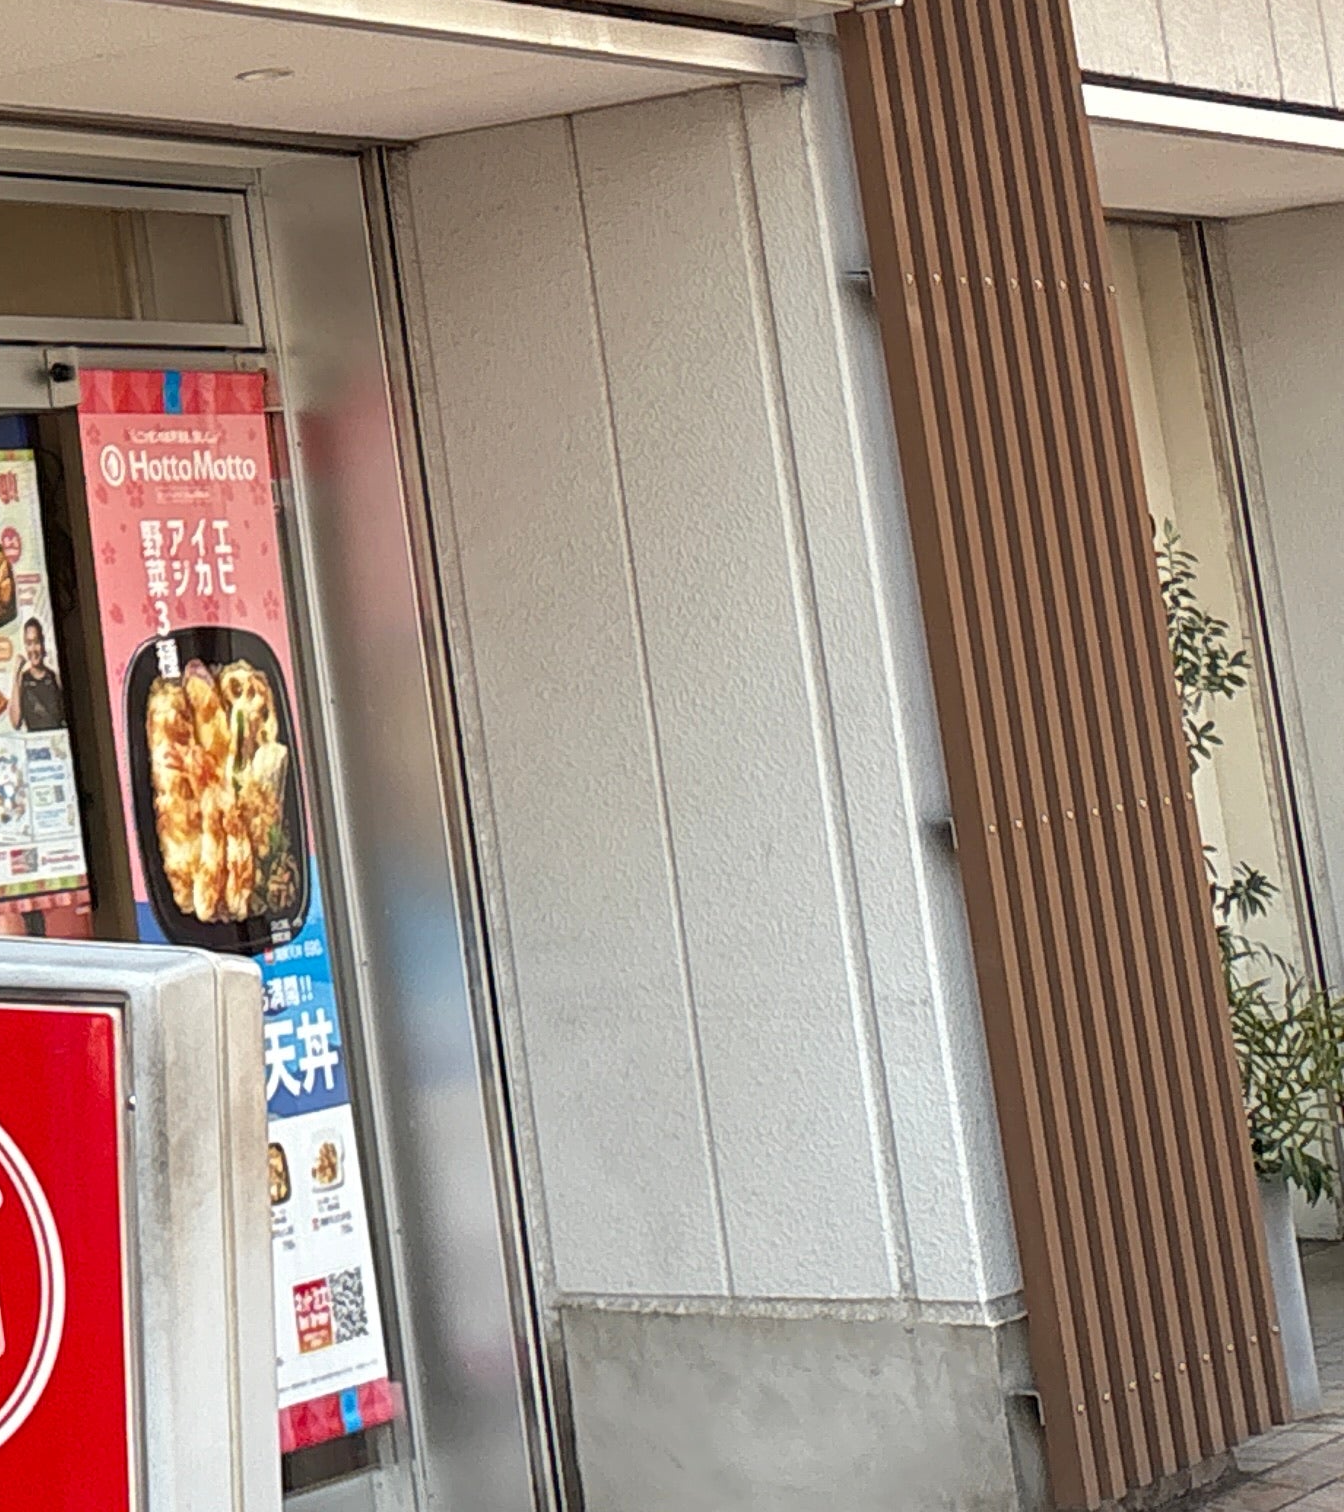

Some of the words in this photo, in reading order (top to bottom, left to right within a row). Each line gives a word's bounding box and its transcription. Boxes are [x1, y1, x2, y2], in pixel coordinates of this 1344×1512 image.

[128, 449, 257, 482] HottoMotto
[166, 519, 191, 597] アジ
[191, 518, 214, 597] イカ
[212, 519, 237, 595] エビ
[139, 519, 182, 678] 野菜3種
[264, 1007, 339, 1102] 天丼
